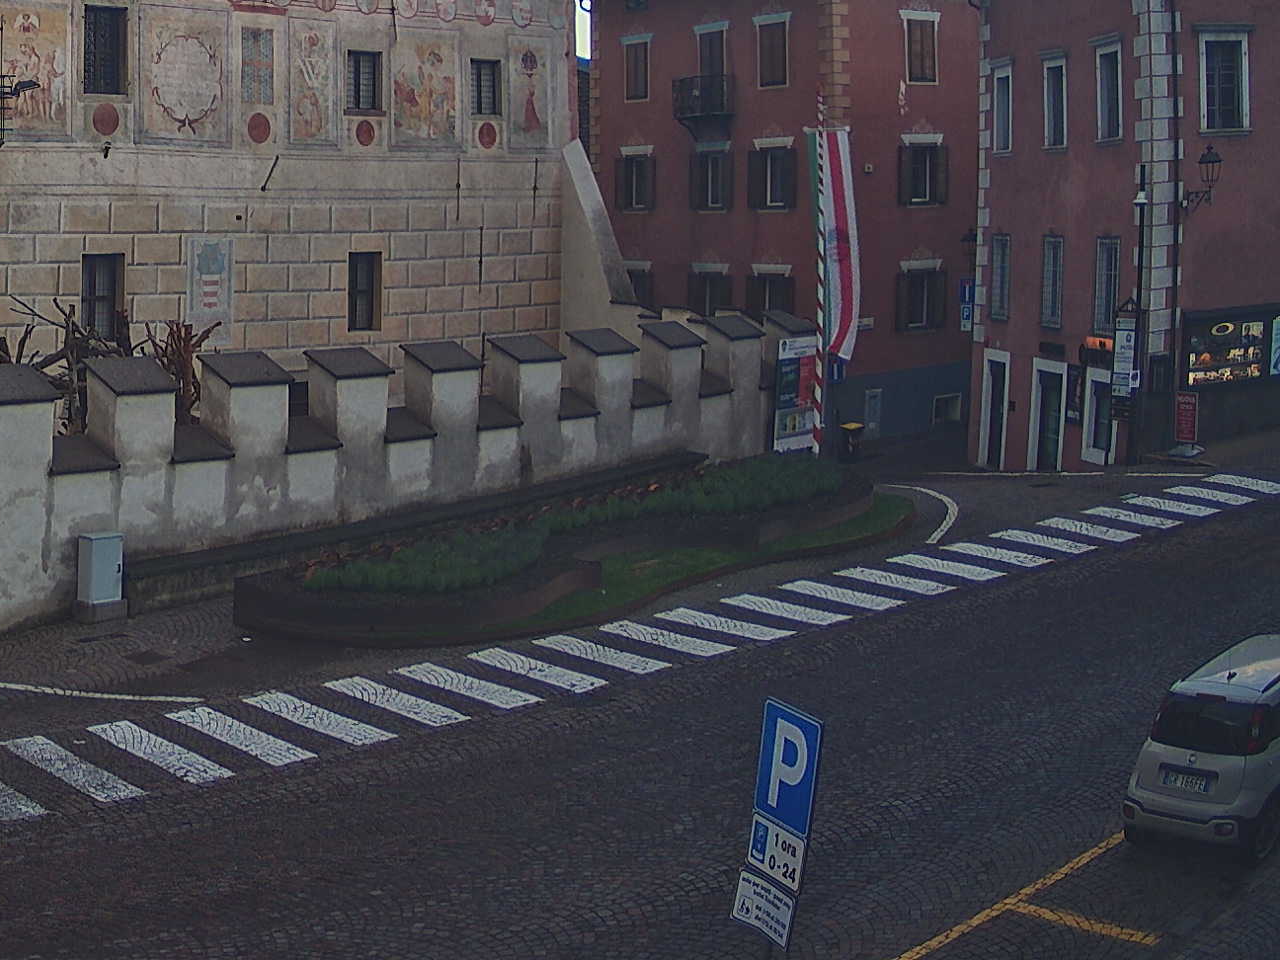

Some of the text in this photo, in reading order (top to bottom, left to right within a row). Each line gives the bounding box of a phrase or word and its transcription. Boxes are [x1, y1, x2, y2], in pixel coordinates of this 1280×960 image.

[767, 717, 808, 808] P
[773, 832, 797, 858] 1 ora
